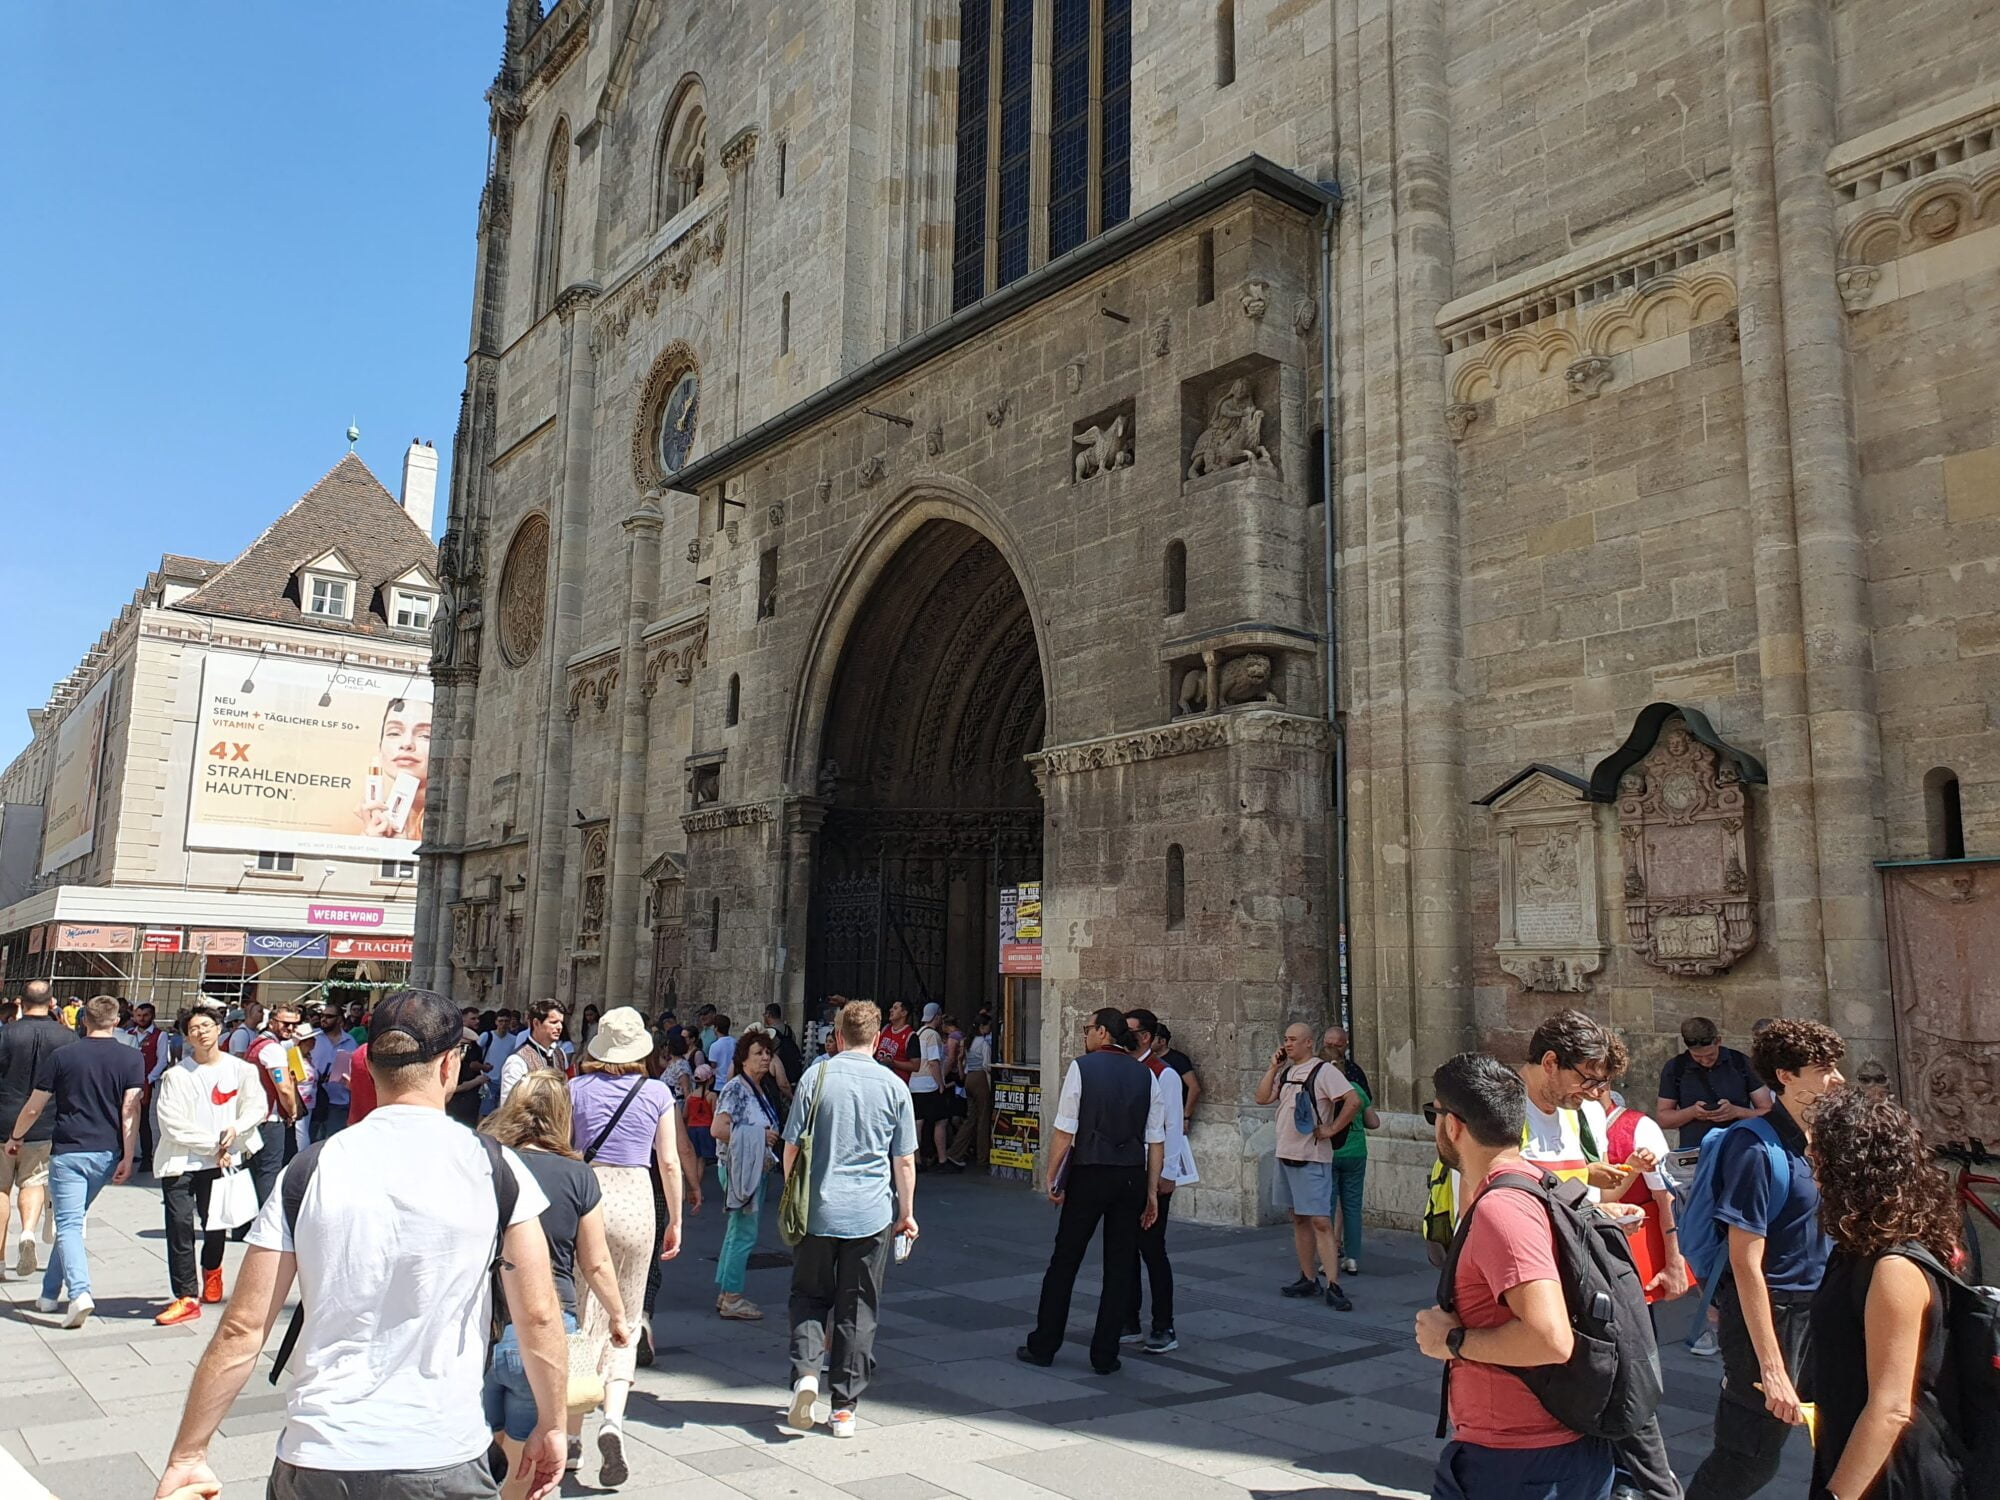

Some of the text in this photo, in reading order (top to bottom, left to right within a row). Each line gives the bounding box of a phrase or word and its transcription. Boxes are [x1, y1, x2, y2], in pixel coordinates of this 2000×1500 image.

[214, 695, 237, 706] NEU
[212, 718, 265, 732] VITAMIN C
[213, 706, 249, 719] SERUM
[264, 712, 319, 727] TÄGLICHER
[321, 719, 339, 729] LSF
[208, 740, 251, 763] 4X
[206, 763, 352, 790] STRAHLENDERER
[313, 908, 380, 923] WERBEWAND
[994, 1090, 1025, 1104] DIE VIER
